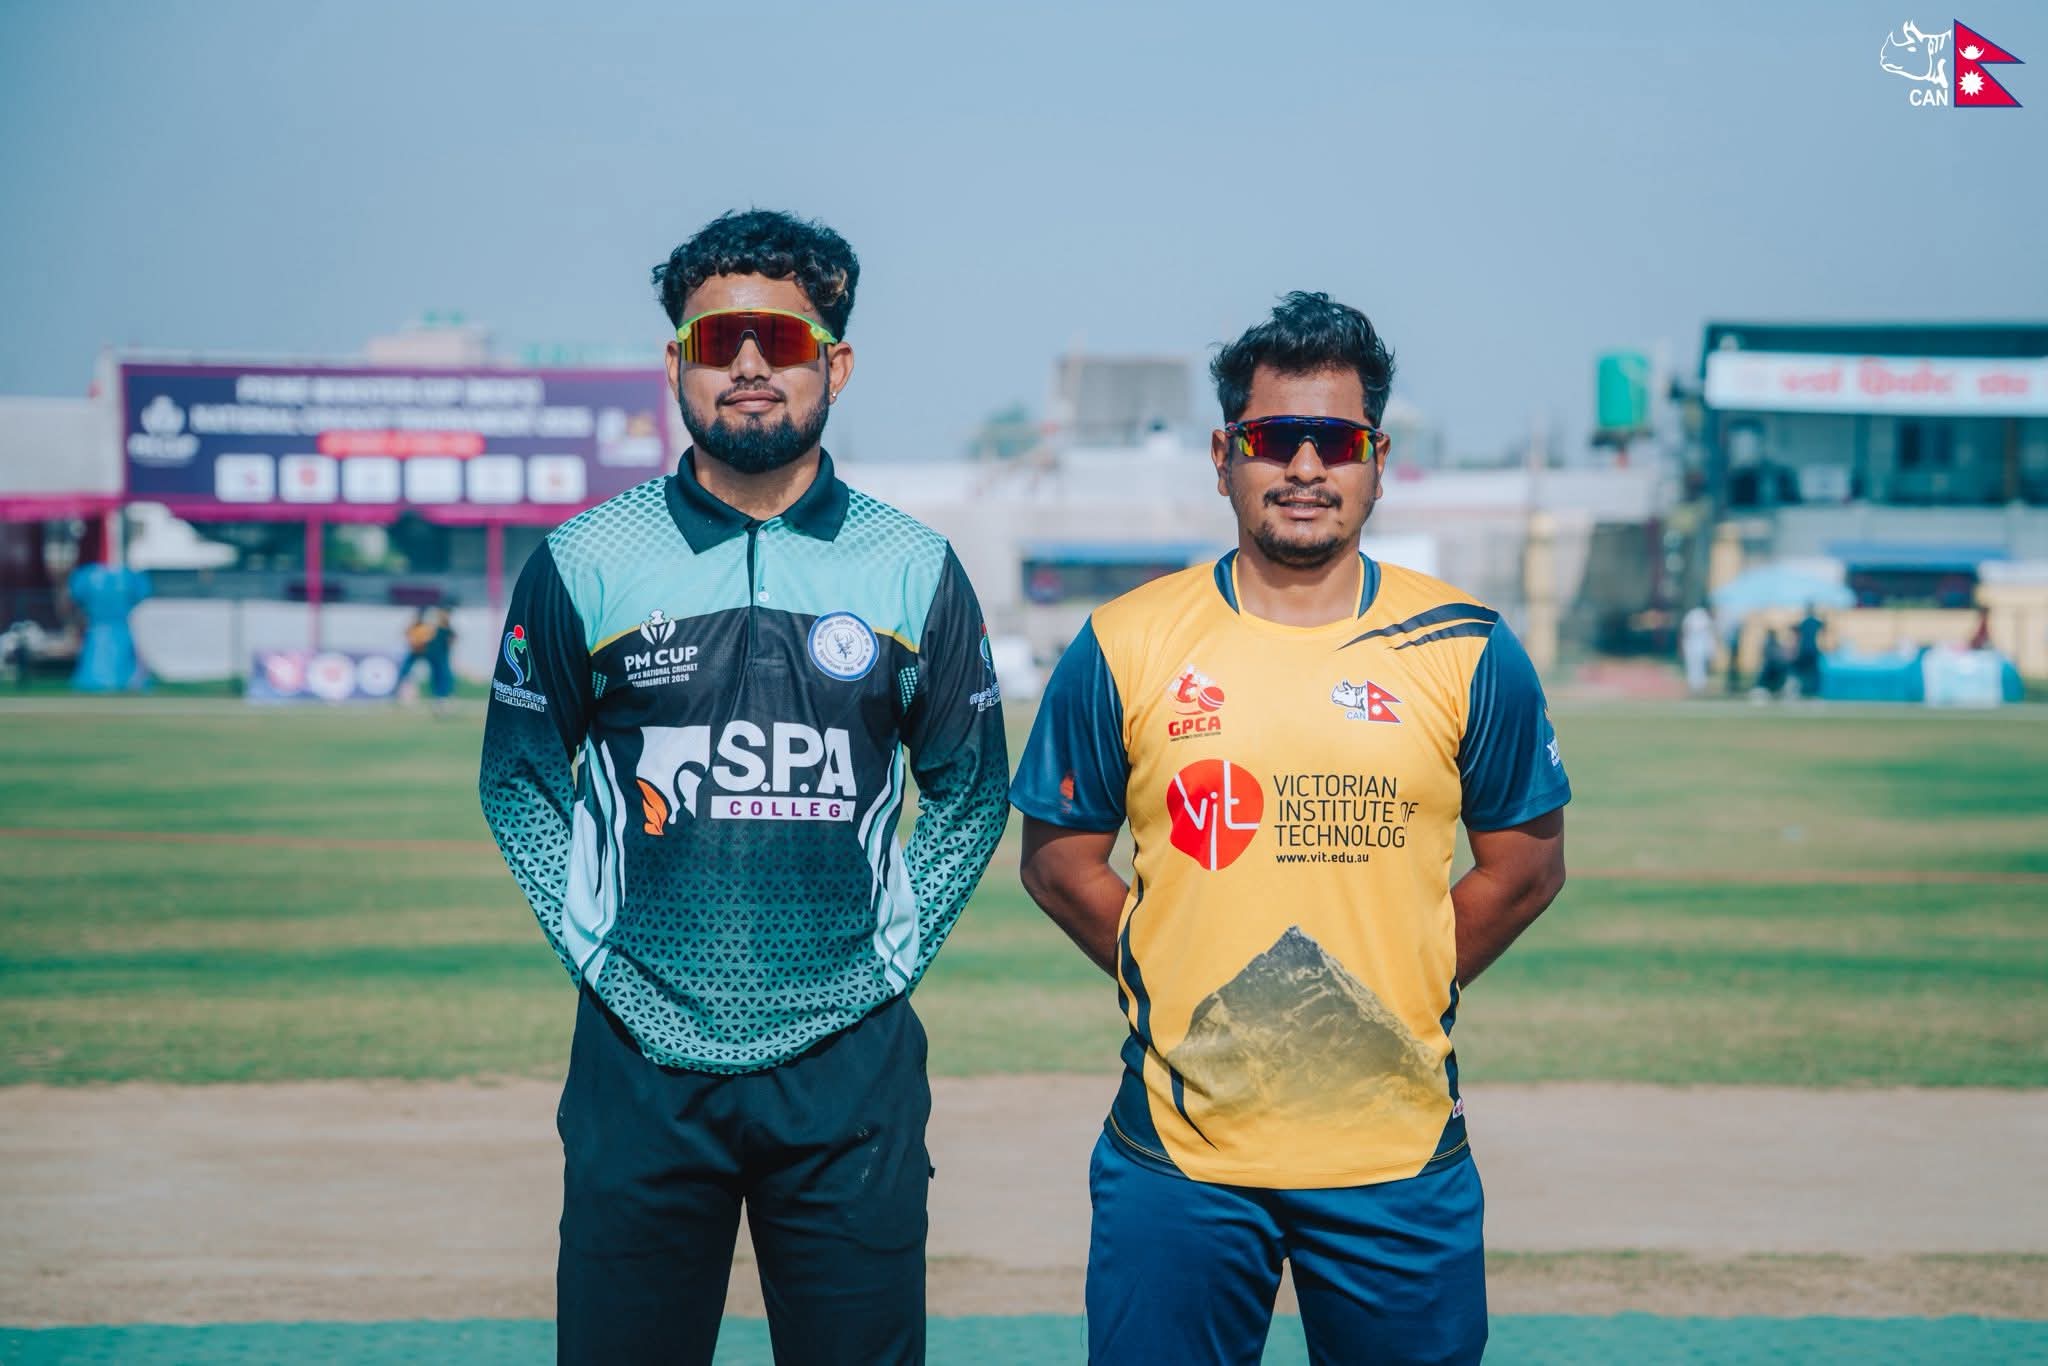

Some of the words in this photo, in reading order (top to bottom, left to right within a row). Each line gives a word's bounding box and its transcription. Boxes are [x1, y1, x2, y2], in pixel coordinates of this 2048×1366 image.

[624, 651, 651, 672] PM
[654, 646, 698, 666] CUP
[631, 676, 670, 689] TOURNAMENT
[671, 673, 690, 684] 2026
[642, 667, 671, 679] NATIONAL
[672, 663, 698, 674] CRICKET
[1346, 711, 1366, 720] CAN
[1168, 716, 1221, 737] GPCA
[712, 720, 857, 797] S.P.A
[1273, 774, 1397, 798] VICTORIAN
[729, 800, 842, 818] COLLEG
[1279, 800, 1396, 823] INSTITUTE
[1400, 801, 1420, 822] OF
[1273, 824, 1407, 848] TECHNOLOG
[1275, 851, 1370, 864] www.vit.edu.au
